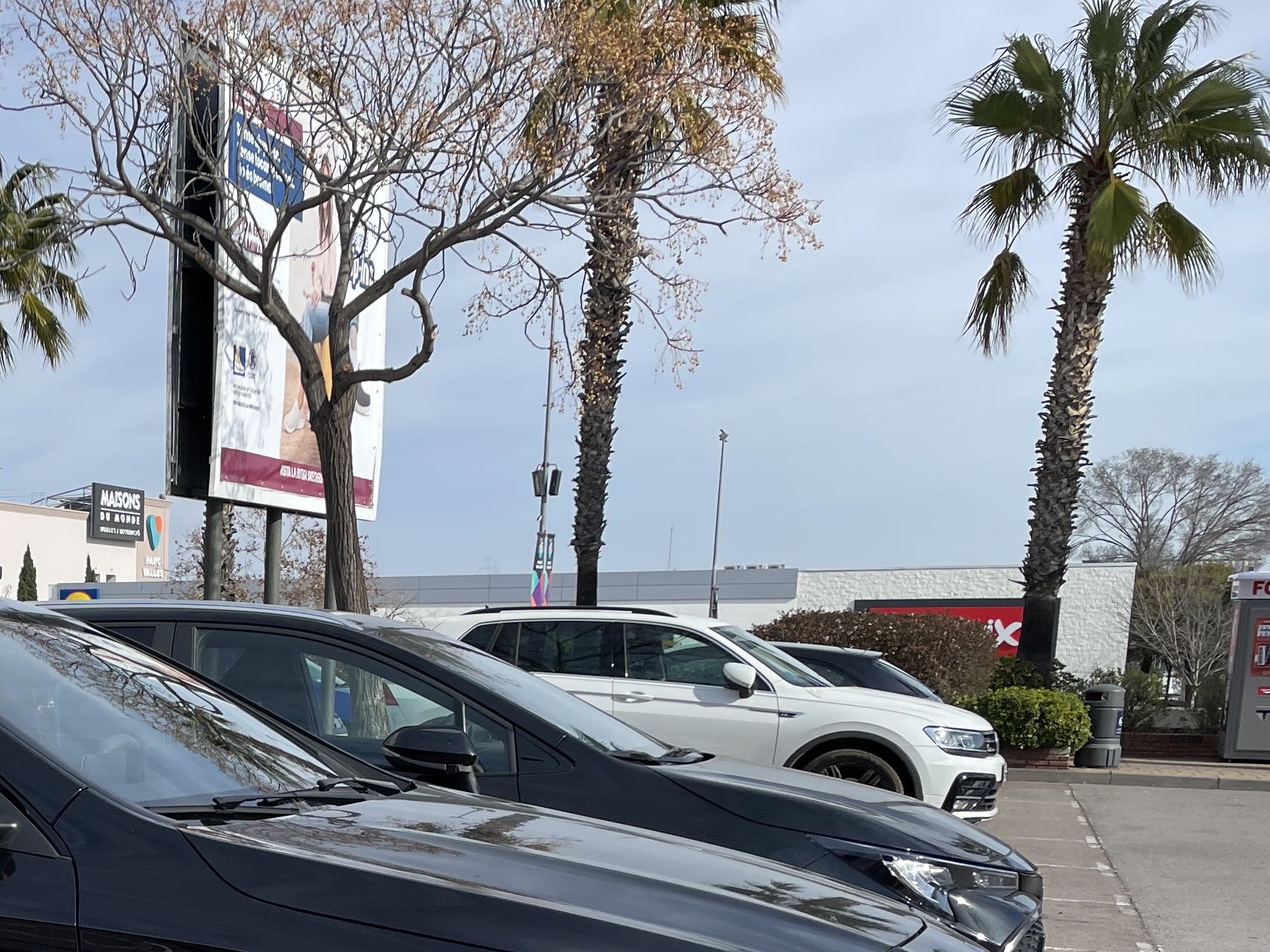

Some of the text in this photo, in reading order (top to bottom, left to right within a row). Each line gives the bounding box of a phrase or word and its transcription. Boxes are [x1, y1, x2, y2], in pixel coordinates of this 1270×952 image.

[100, 489, 140, 510] MAISONS
[100, 512, 140, 525] DU MONDE
